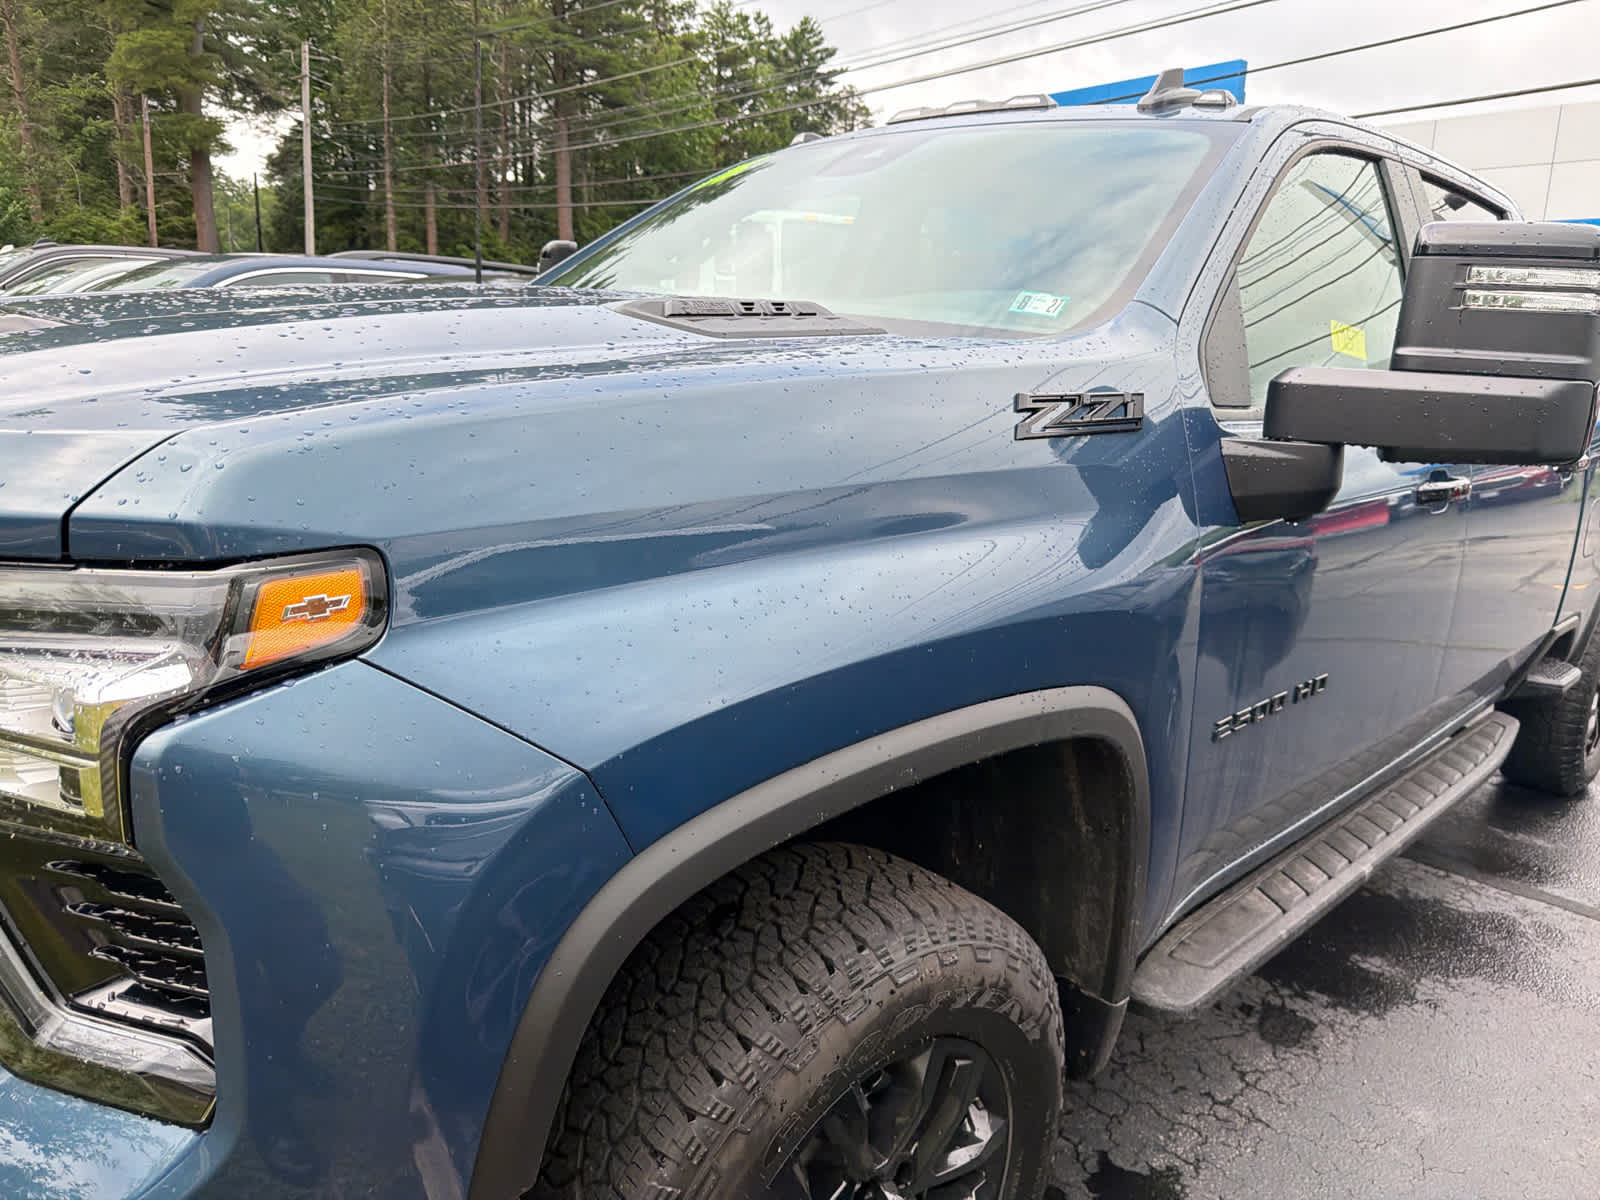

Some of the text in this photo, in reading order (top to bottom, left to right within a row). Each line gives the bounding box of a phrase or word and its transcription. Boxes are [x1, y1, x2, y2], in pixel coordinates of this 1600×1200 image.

[1014, 392, 1145, 440] Z71
[1211, 673, 1329, 743] 2500 HD
